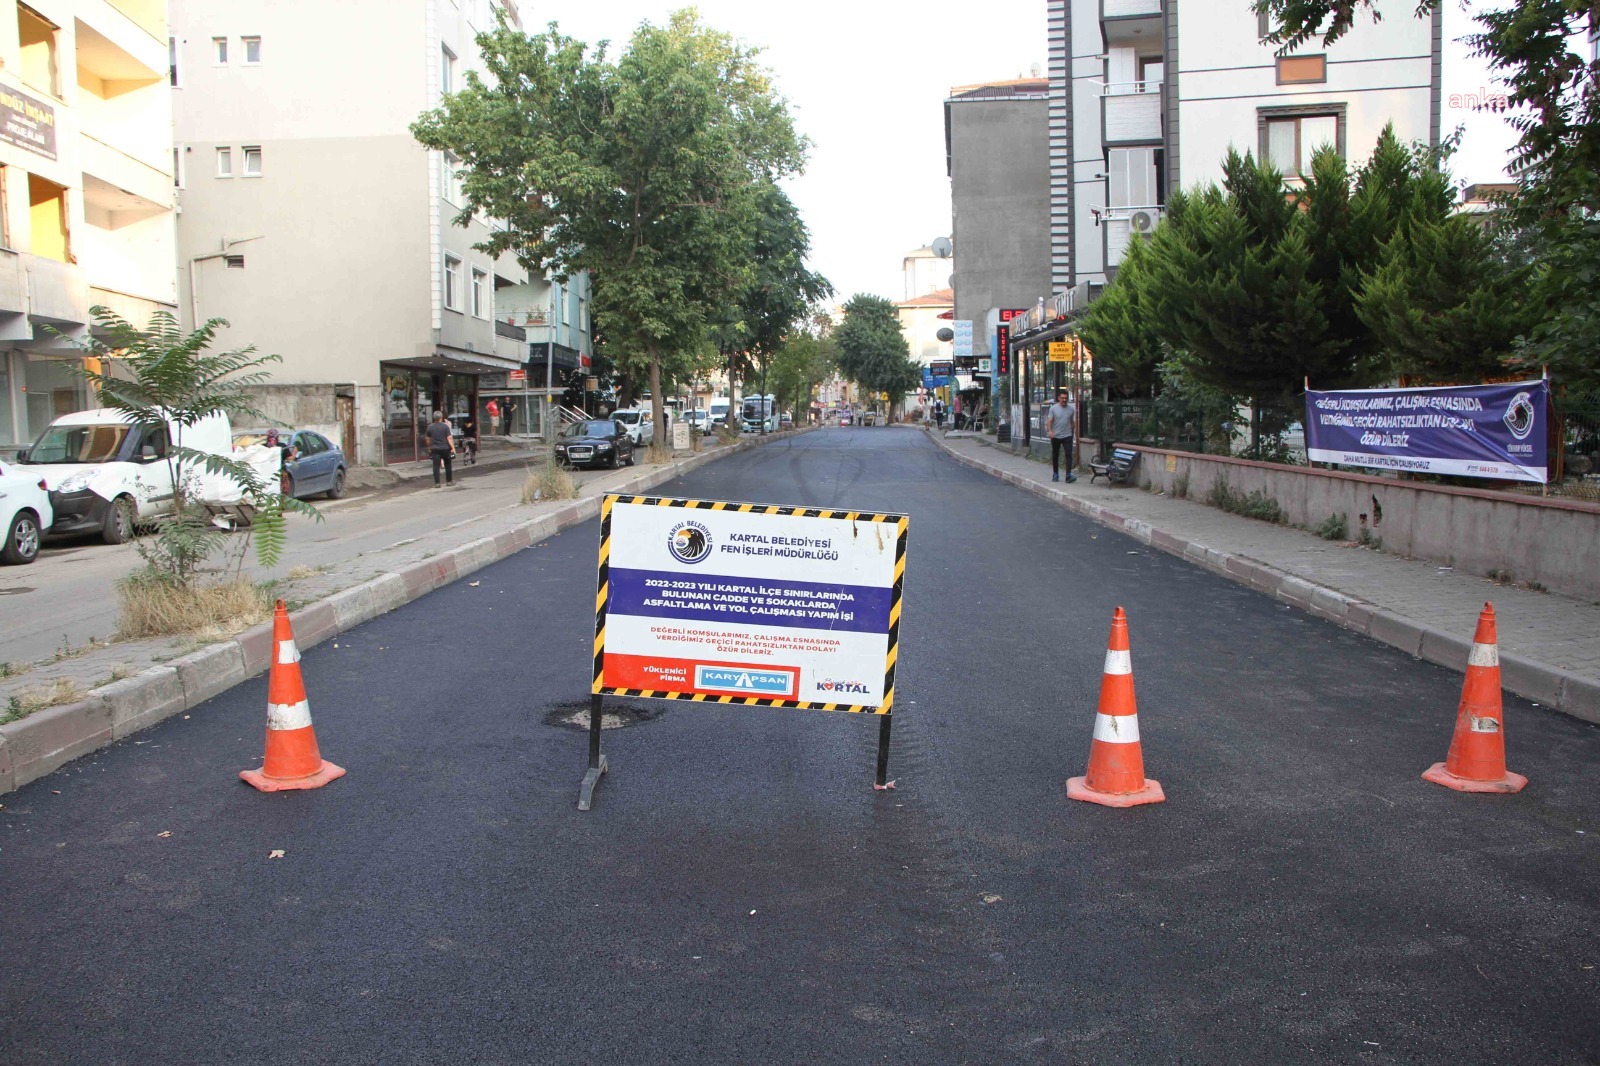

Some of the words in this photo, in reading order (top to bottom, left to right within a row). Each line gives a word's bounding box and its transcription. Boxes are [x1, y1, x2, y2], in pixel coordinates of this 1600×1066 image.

[1376, 414, 1441, 428] RAHATSIZLIKTAN
[668, 521, 685, 541] KARTAL
[687, 520, 713, 543] BELEDİYESİ
[730, 533, 769, 544] KARTAL
[772, 536, 831, 548] BELEDİYESİ
[720, 544, 740, 554] FEN
[742, 544, 773, 556] İŞLERİ
[774, 547, 839, 561] MÜDÜRLÜĞÜ
[645, 579, 696, 590] 2022-2023
[698, 582, 716, 591] YILI
[718, 584, 758, 594] KARTAL
[759, 586, 782, 597] İLÇE
[784, 588, 854, 602] SINIRLARINDA
[662, 590, 712, 600] BULUNAN
[713, 594, 749, 604] CADDE
[750, 596, 764, 604] VE
[766, 598, 836, 610] SOKAKLARDA
[643, 598, 712, 610] ASFALTLAMA
[713, 604, 728, 612] VE
[728, 604, 748, 613] YOL
[750, 606, 806, 618] ÇALIŞMASI
[808, 610, 839, 620] YAPIM
[840, 611, 854, 621] İŞİ
[650, 626, 685, 634] DEĞERLİ
[687, 630, 752, 640] KOMŞULARIMIZ,
[754, 634, 791, 642] ÇALIŞMA
[793, 636, 840, 646] ESNASINDA
[656, 634, 704, 644] VERDİĞİMİZ
[706, 637, 734, 646] GEÇİCİ
[735, 640, 804, 650] RAHATSIZLIKTAN
[716, 645, 739, 653] ÖZÜR
[740, 646, 774, 656] DİLERİZ.
[643, 666, 686, 675] YÜKLENİCİ
[660, 674, 686, 683] FİRMA
